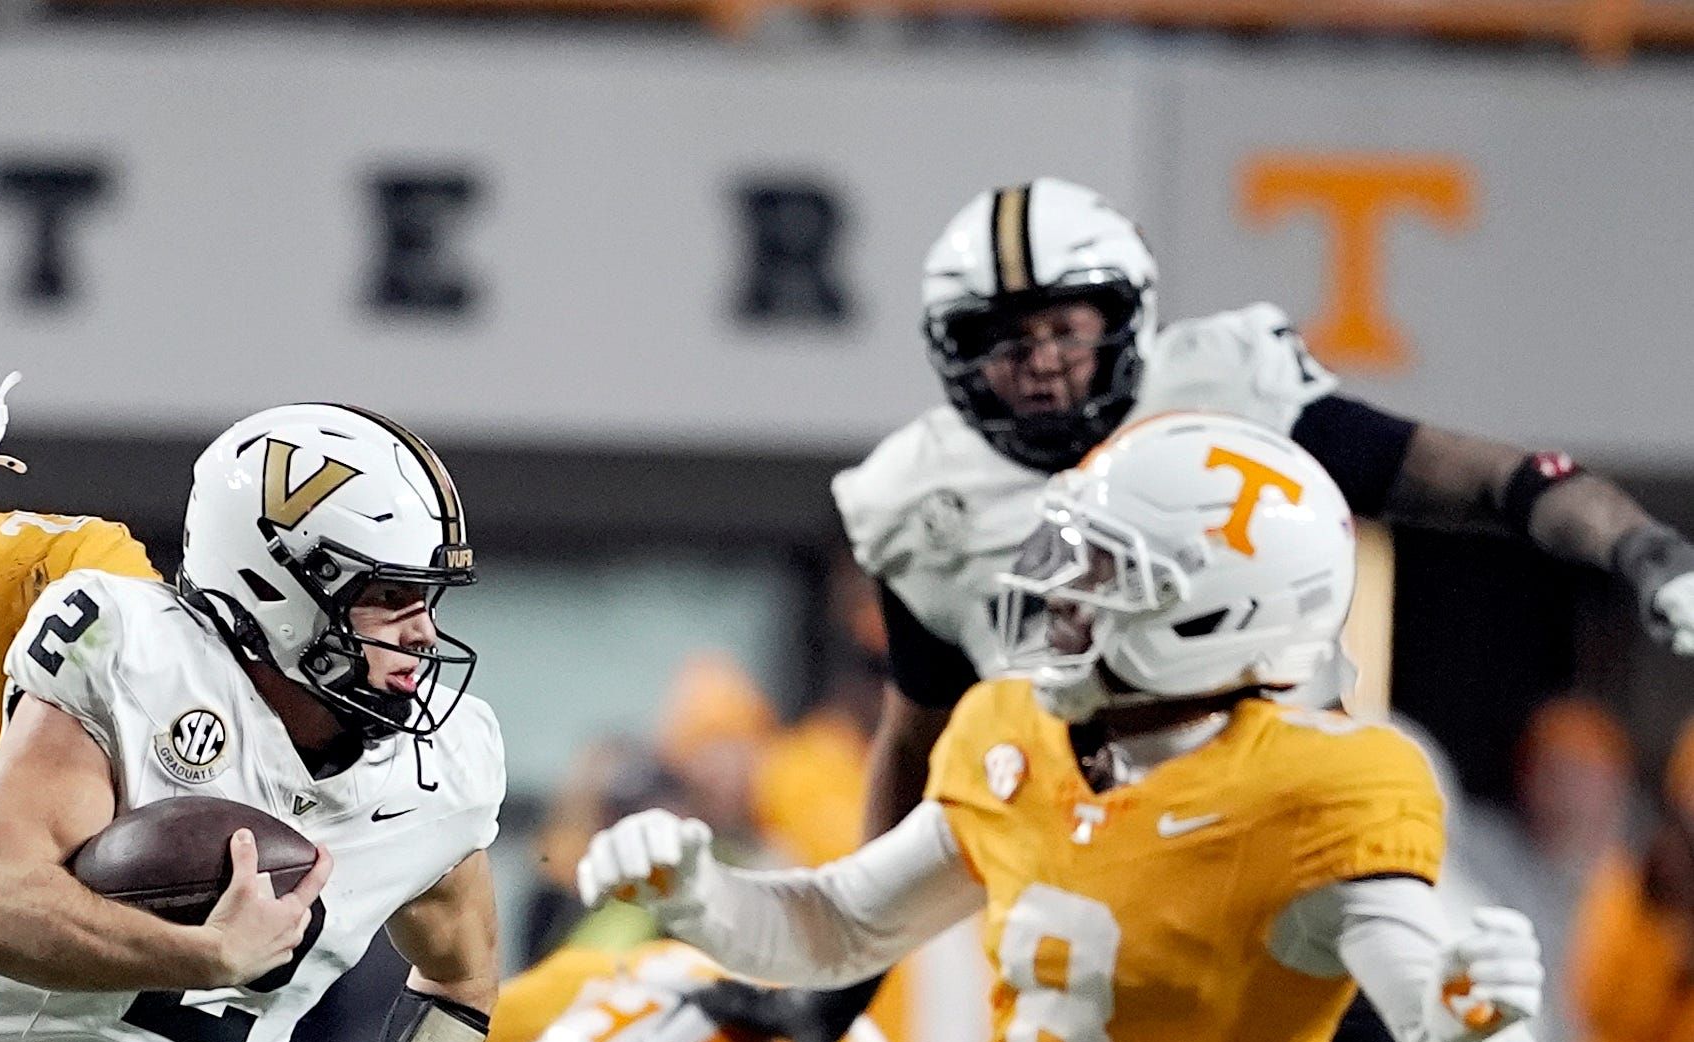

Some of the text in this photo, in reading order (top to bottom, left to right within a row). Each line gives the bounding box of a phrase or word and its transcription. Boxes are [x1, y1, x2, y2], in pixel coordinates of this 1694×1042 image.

[1236, 156, 1478, 370] T
[263, 438, 364, 531] V
[1206, 447, 1303, 557] T
[28, 589, 99, 677] 2
[160, 746, 216, 781] GRADUATE
[173, 710, 225, 764] SEC
[293, 795, 317, 816] V
